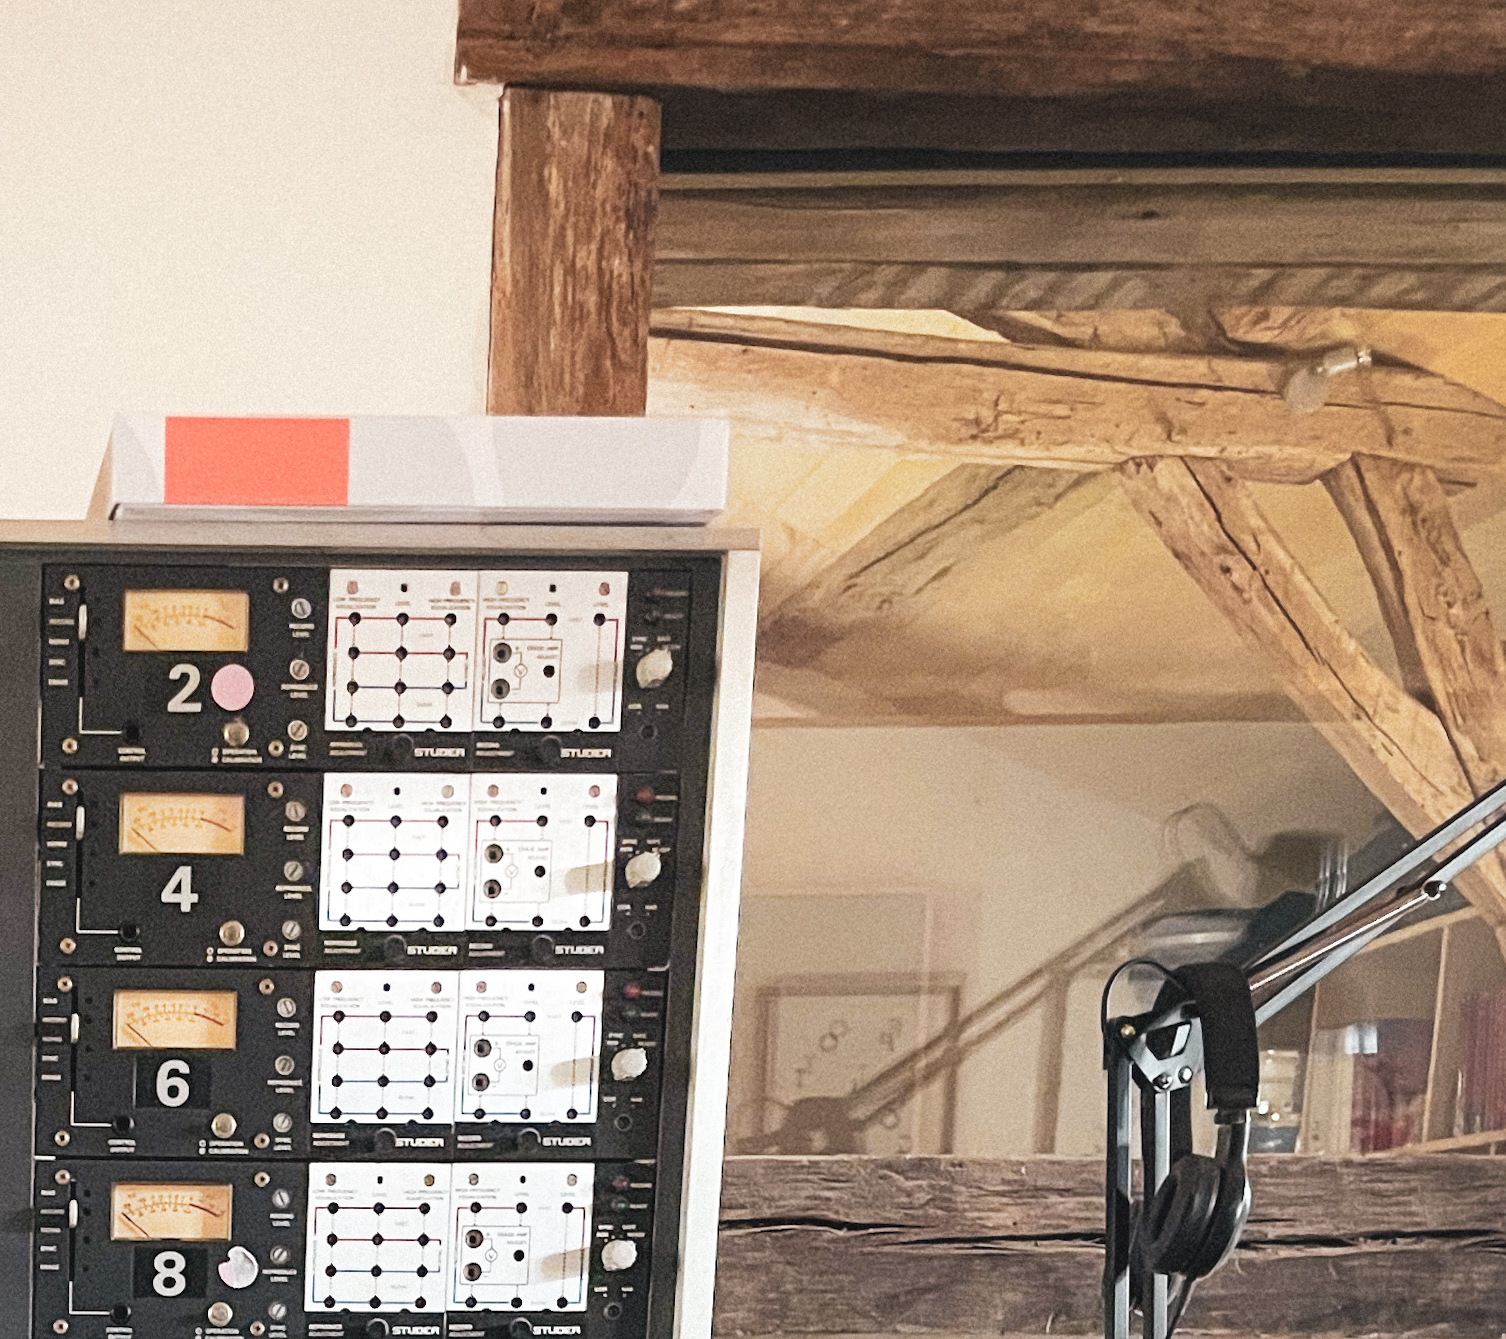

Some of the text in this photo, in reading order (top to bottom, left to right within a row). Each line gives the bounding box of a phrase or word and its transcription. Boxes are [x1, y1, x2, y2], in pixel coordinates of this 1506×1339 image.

[167, 663, 202, 713] 2
[413, 747, 466, 758] STUDER
[560, 747, 612, 759] STUDER
[160, 865, 199, 913] 4
[405, 943, 458, 956] STUDER
[555, 944, 606, 956] STUDER
[156, 1059, 190, 1107] 6
[393, 1136, 445, 1148] STUDER
[541, 1136, 592, 1148] STUDER
[152, 1250, 186, 1297] 8
[391, 1325, 440, 1336] STUDER
[532, 1325, 582, 1336] STUDER
